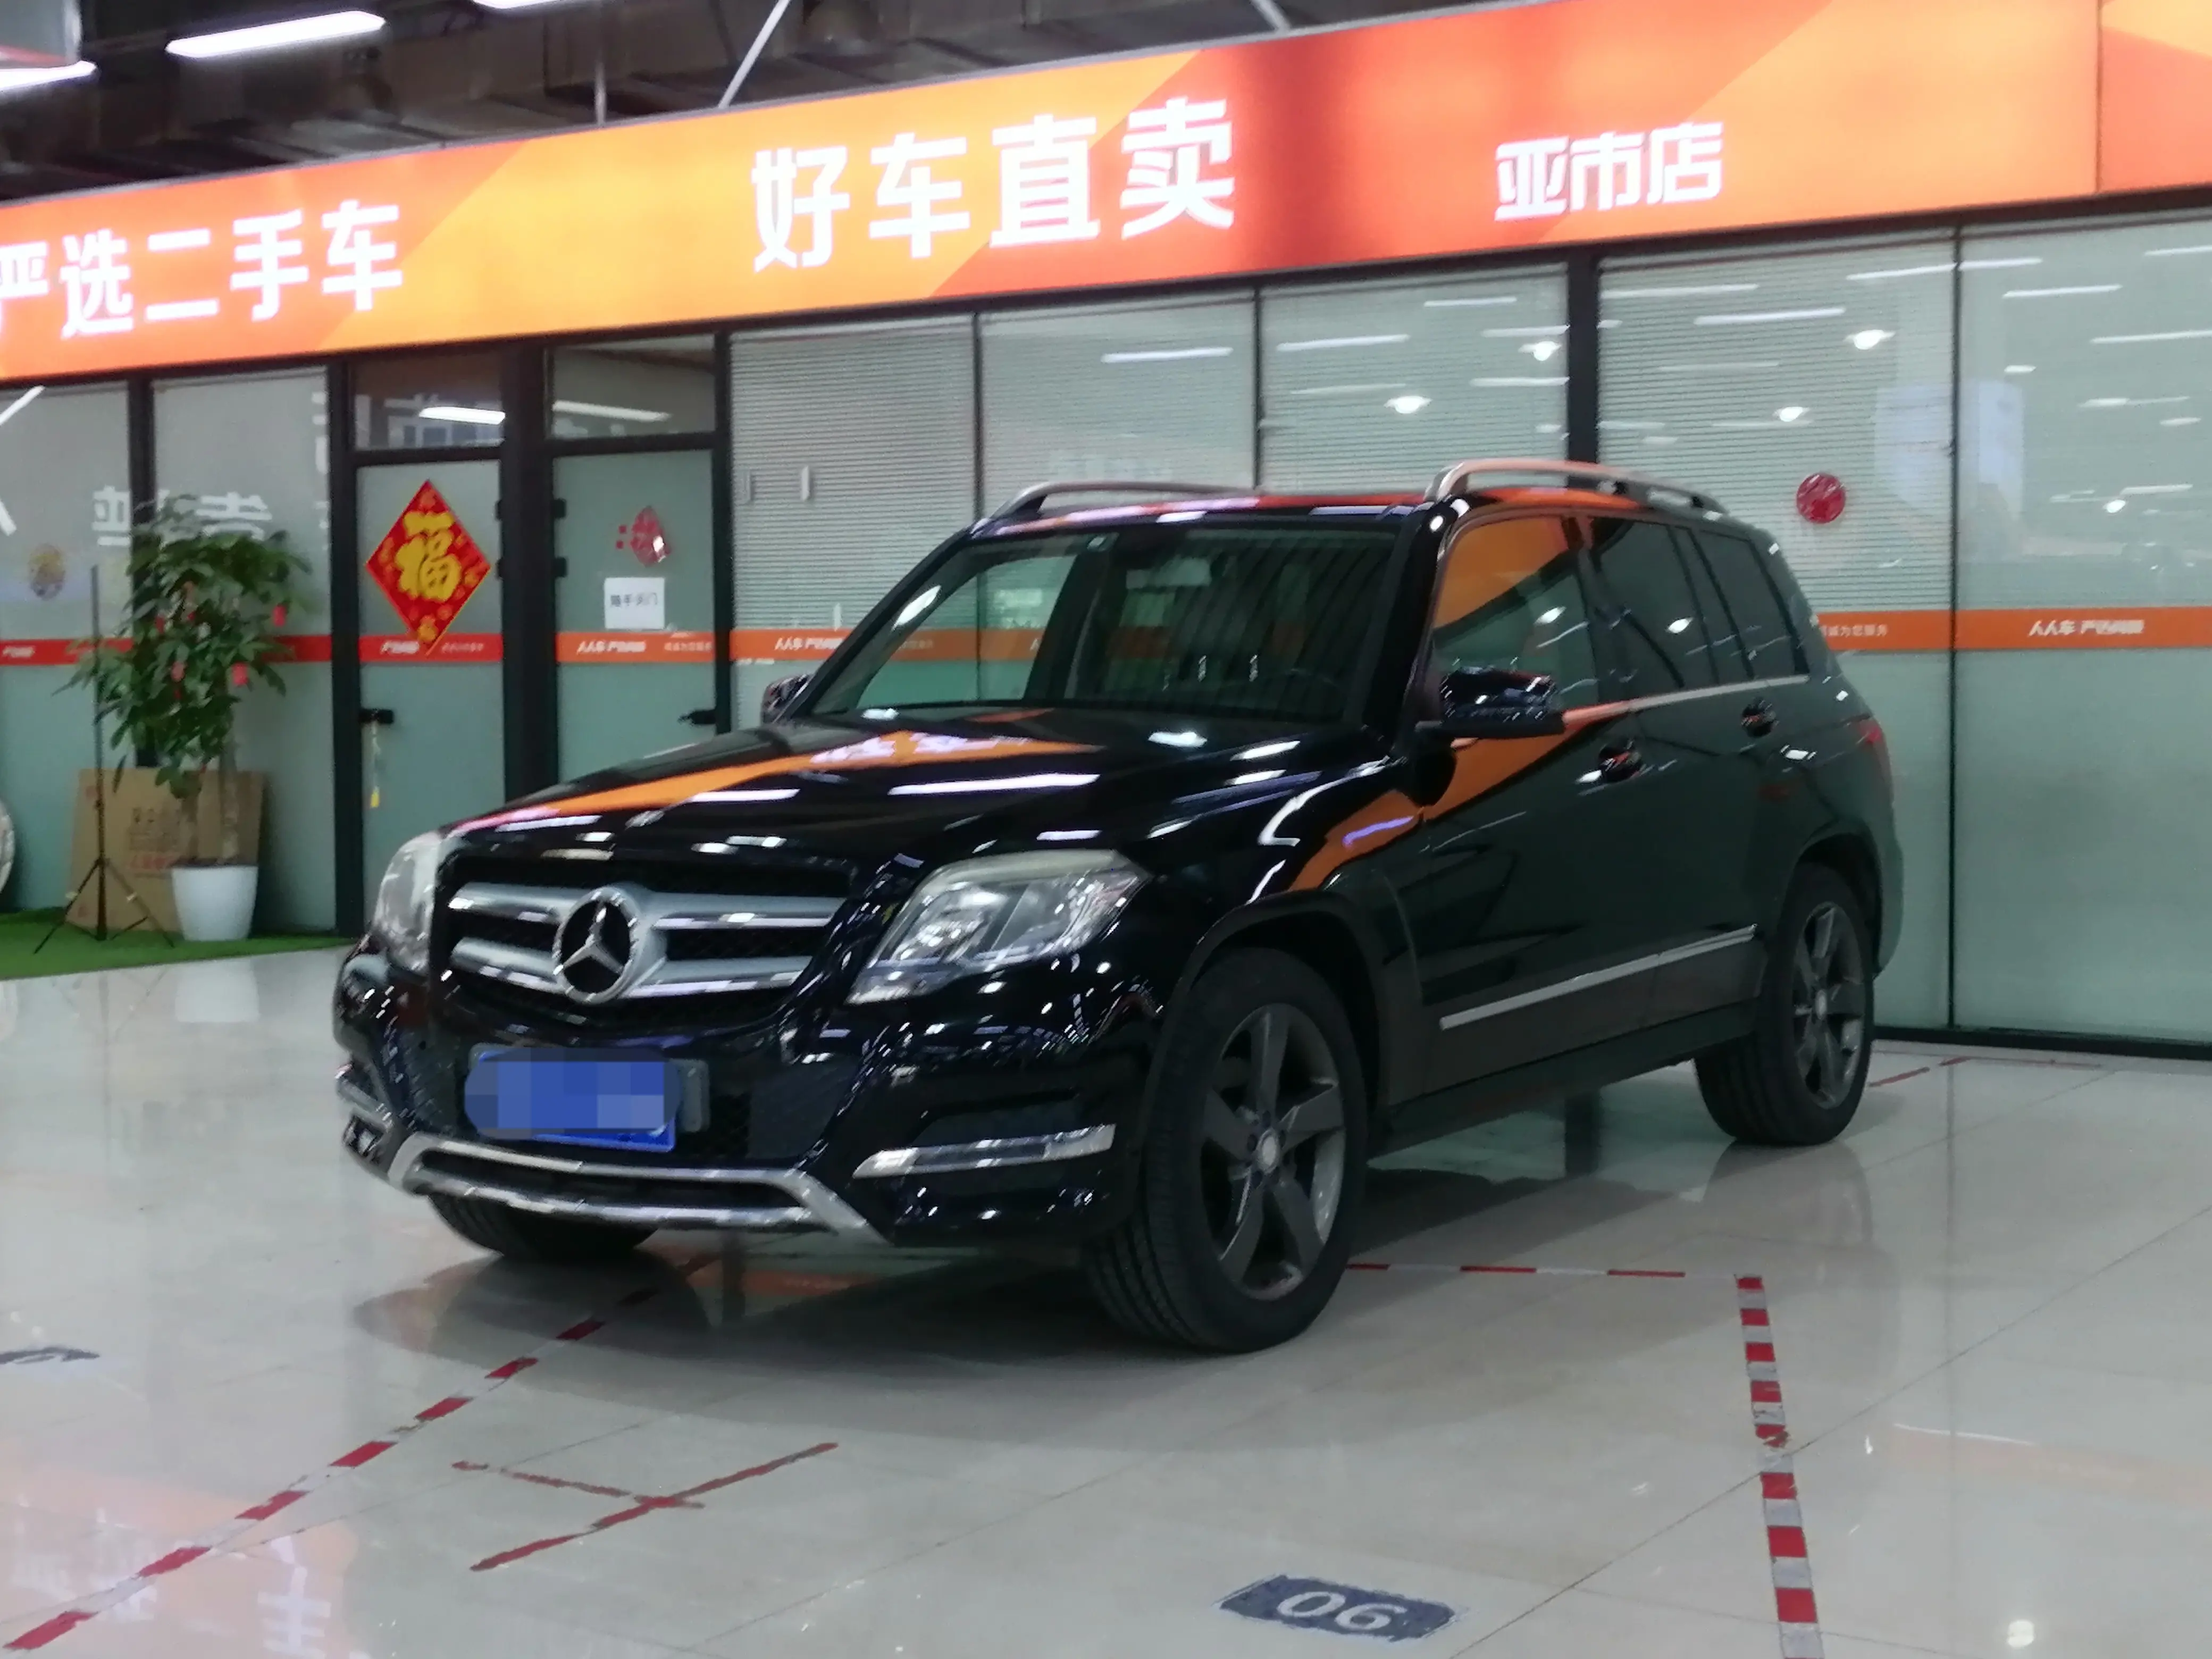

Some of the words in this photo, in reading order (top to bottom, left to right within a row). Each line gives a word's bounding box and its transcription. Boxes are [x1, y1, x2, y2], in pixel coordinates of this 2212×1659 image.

[751, 96, 1235, 273] 好车直卖
[1494, 121, 1723, 221] 亚市店
[0, 199, 403, 340] 严选二手车
[395, 512, 462, 603] 福
[1277, 1591, 1408, 1631] 06
